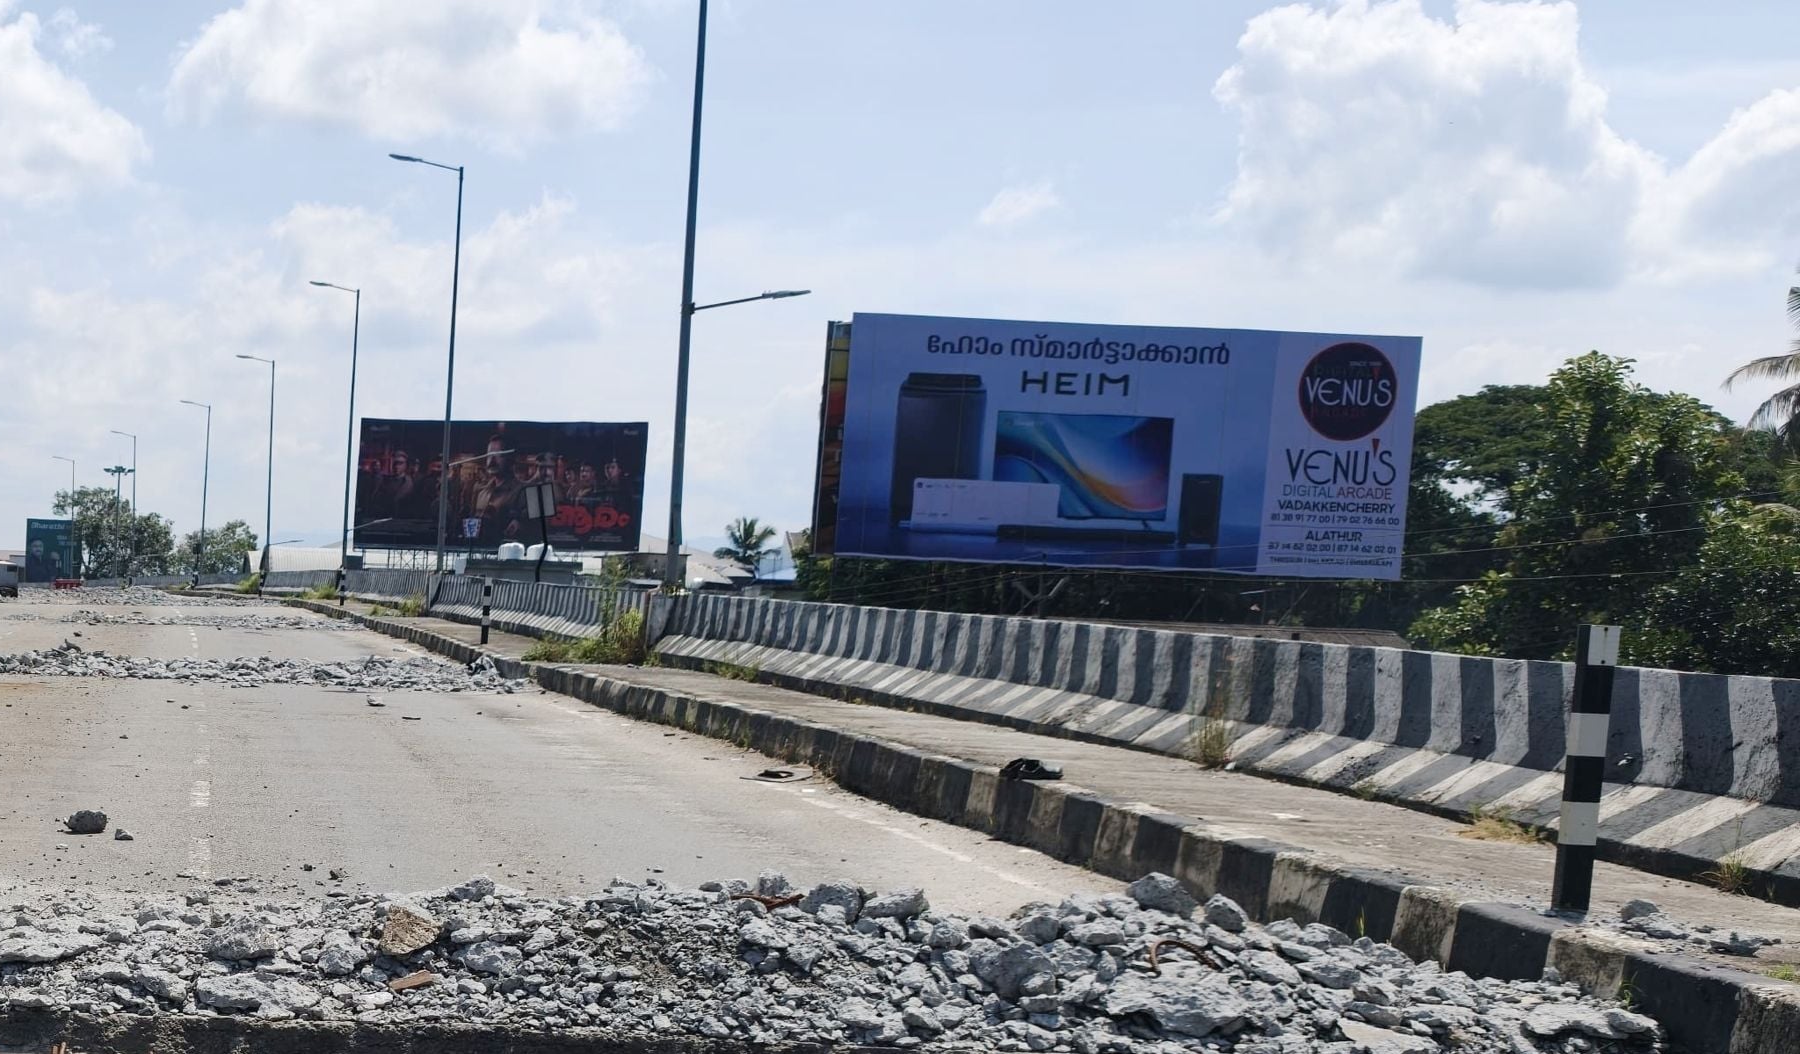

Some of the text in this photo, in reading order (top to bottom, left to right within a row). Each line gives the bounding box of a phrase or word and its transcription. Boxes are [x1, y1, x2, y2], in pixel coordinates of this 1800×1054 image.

[927, 334, 1004, 355] ഹോം
[1020, 370, 1131, 396] HEIM
[1286, 438, 1397, 487] VENU'S
[1282, 484, 1393, 501] DIGITAL ARCADE
[1277, 500, 1396, 514] VADAKKENCHERRY
[1305, 530, 1363, 542] ALATHUR
